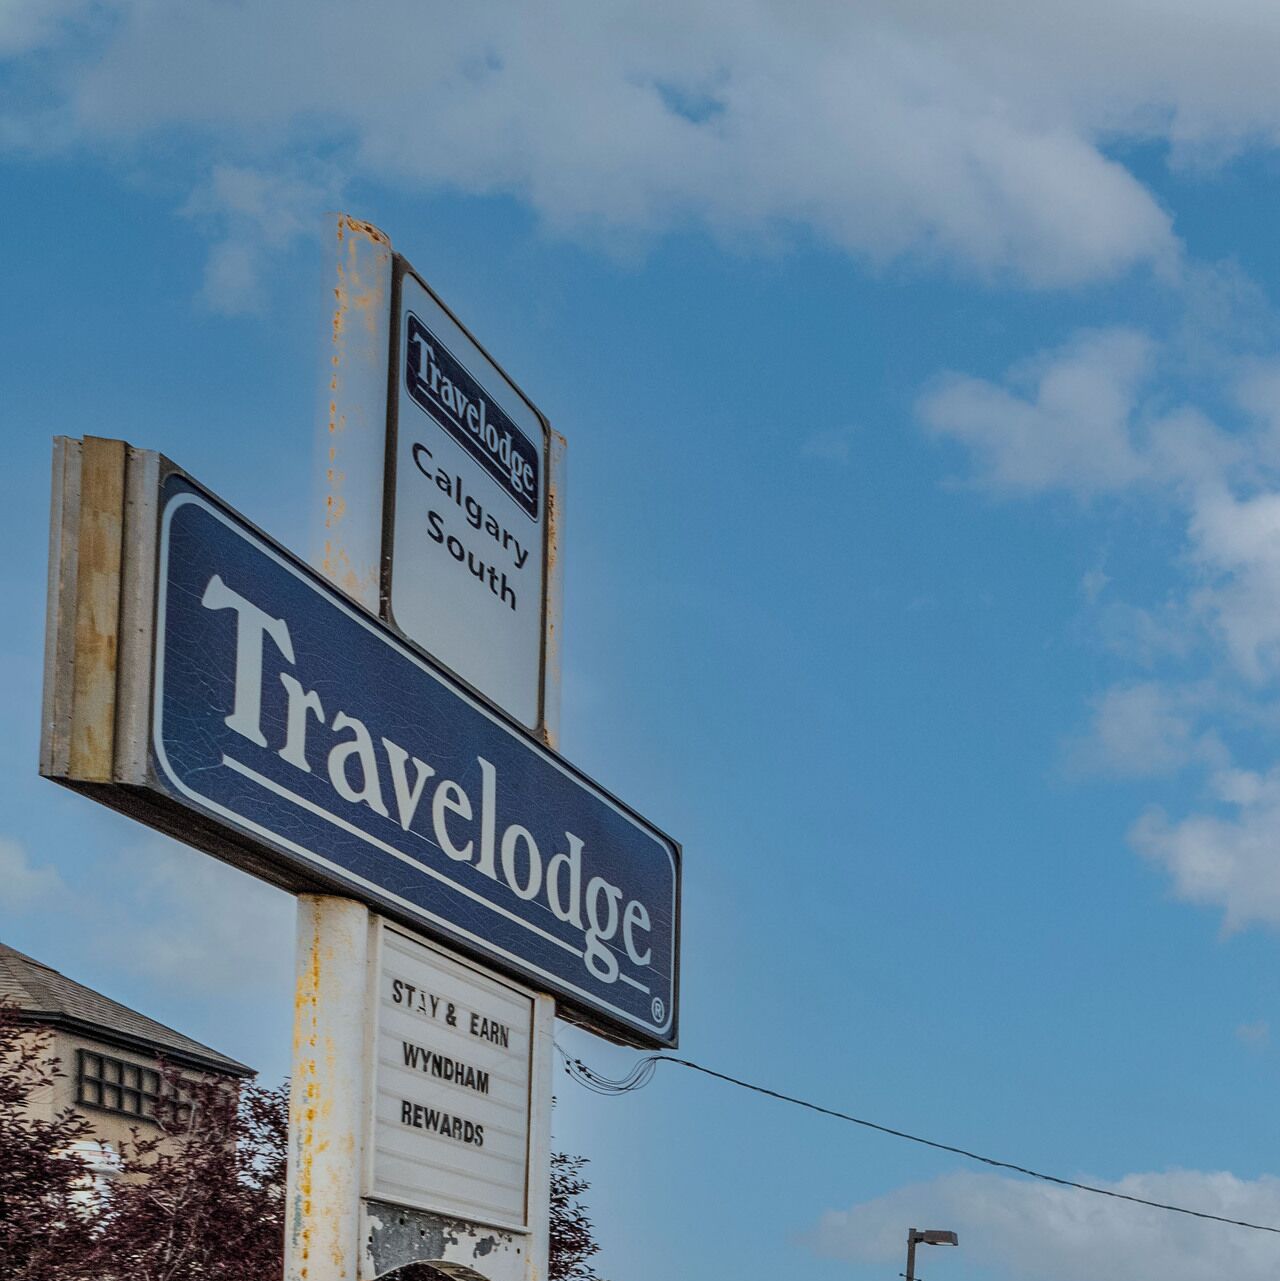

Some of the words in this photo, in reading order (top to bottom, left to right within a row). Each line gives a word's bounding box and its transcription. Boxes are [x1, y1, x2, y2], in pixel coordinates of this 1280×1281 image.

[411, 332, 535, 492] Travelodge
[412, 442, 530, 569] Calgary
[427, 509, 518, 611] South
[201, 573, 653, 984] Travelodge
[402, 1040, 490, 1095] WYNDHAM
[445, 1002, 457, 1027] &
[469, 1012, 510, 1049] EARN
[400, 1100, 485, 1148] REWARDS
